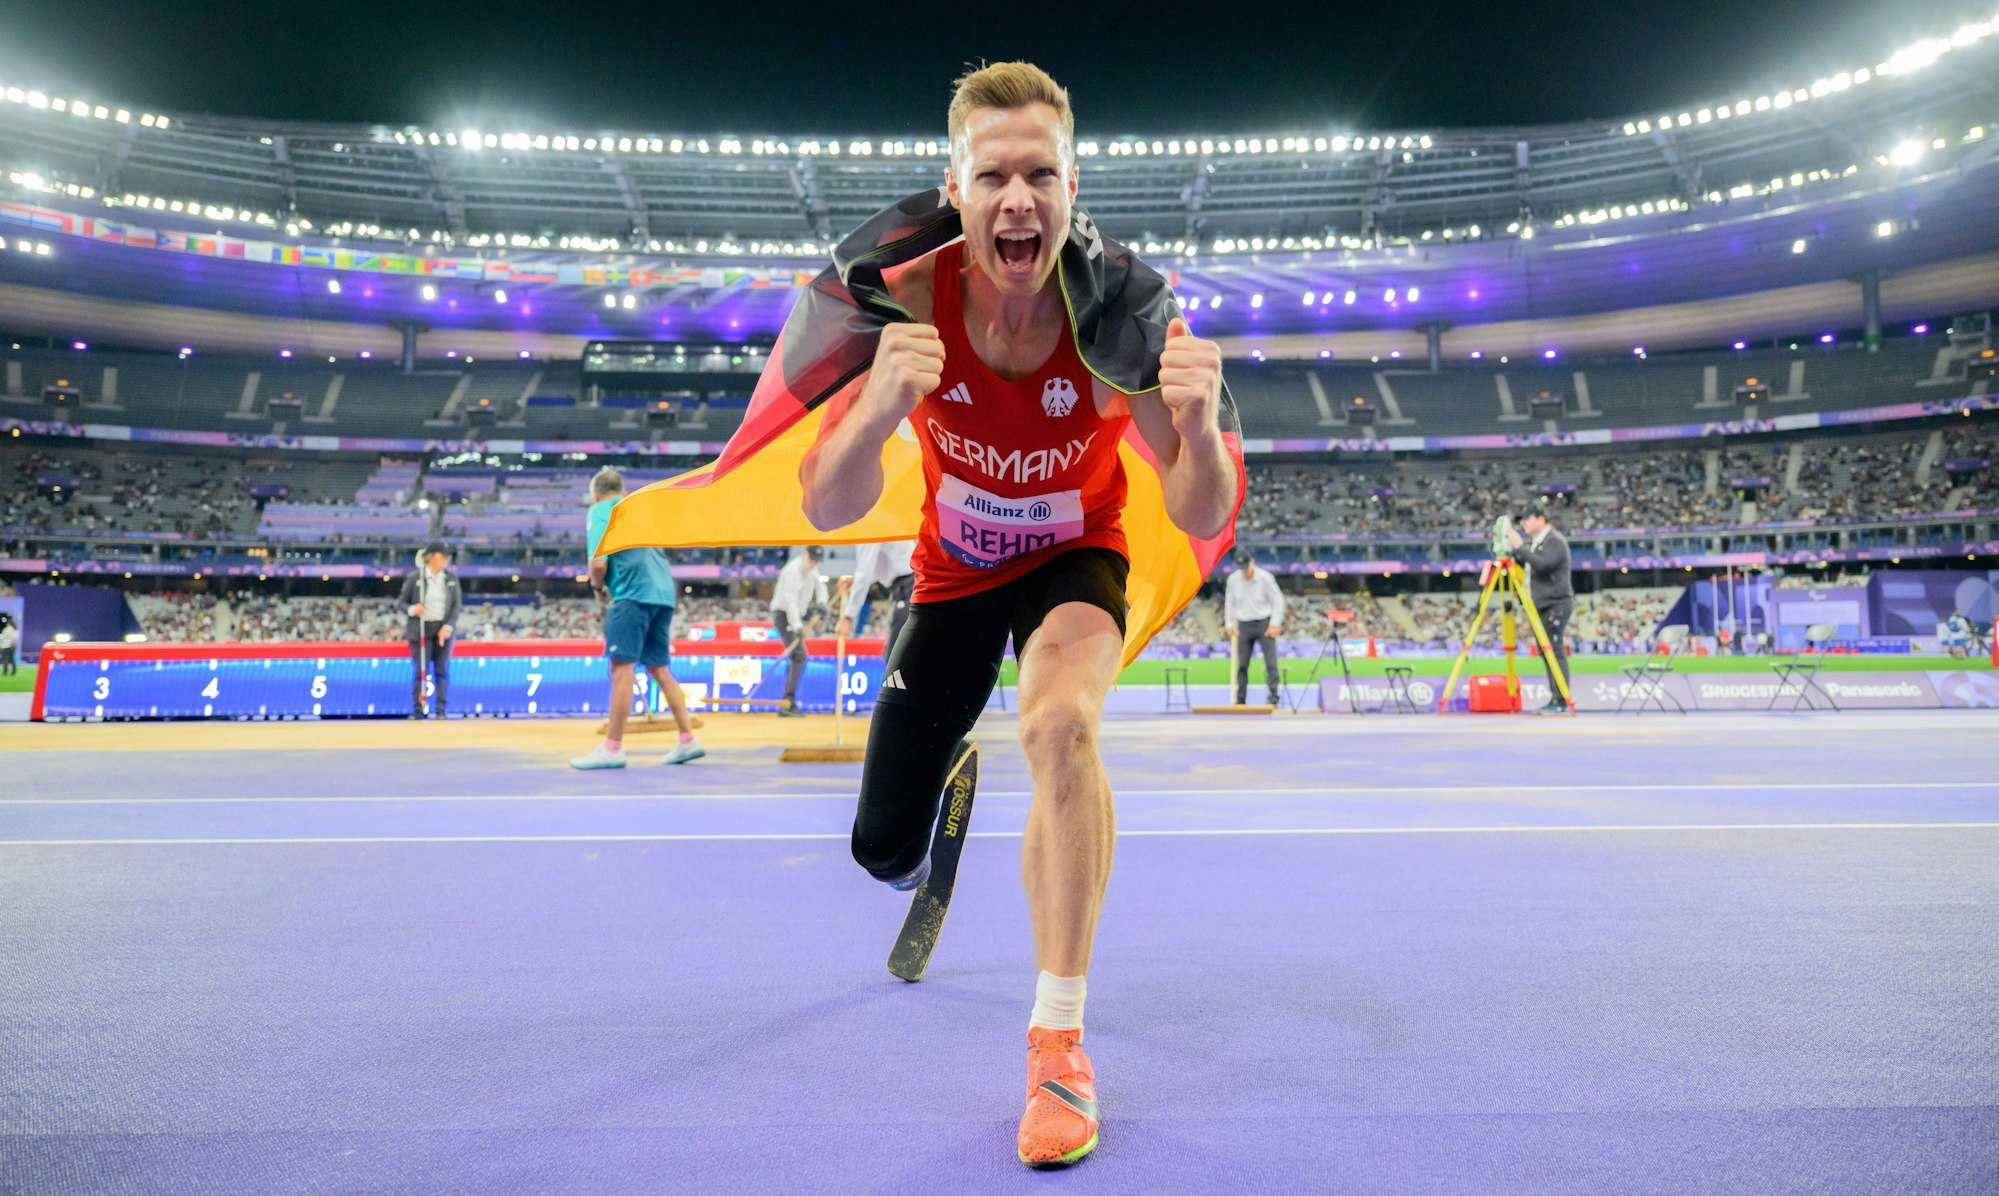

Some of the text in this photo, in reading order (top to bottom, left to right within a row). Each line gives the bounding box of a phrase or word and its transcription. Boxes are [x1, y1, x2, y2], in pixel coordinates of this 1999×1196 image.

[927, 418, 1098, 484] GERMANY
[964, 494, 1024, 517] Allianz
[961, 519, 1056, 555] REHM
[93, 676, 110, 700] 3
[201, 677, 220, 699] 4
[310, 675, 328, 698] 5
[527, 674, 543, 697] 7
[840, 671, 868, 695] 10
[1827, 683, 1922, 700] Panasonic
